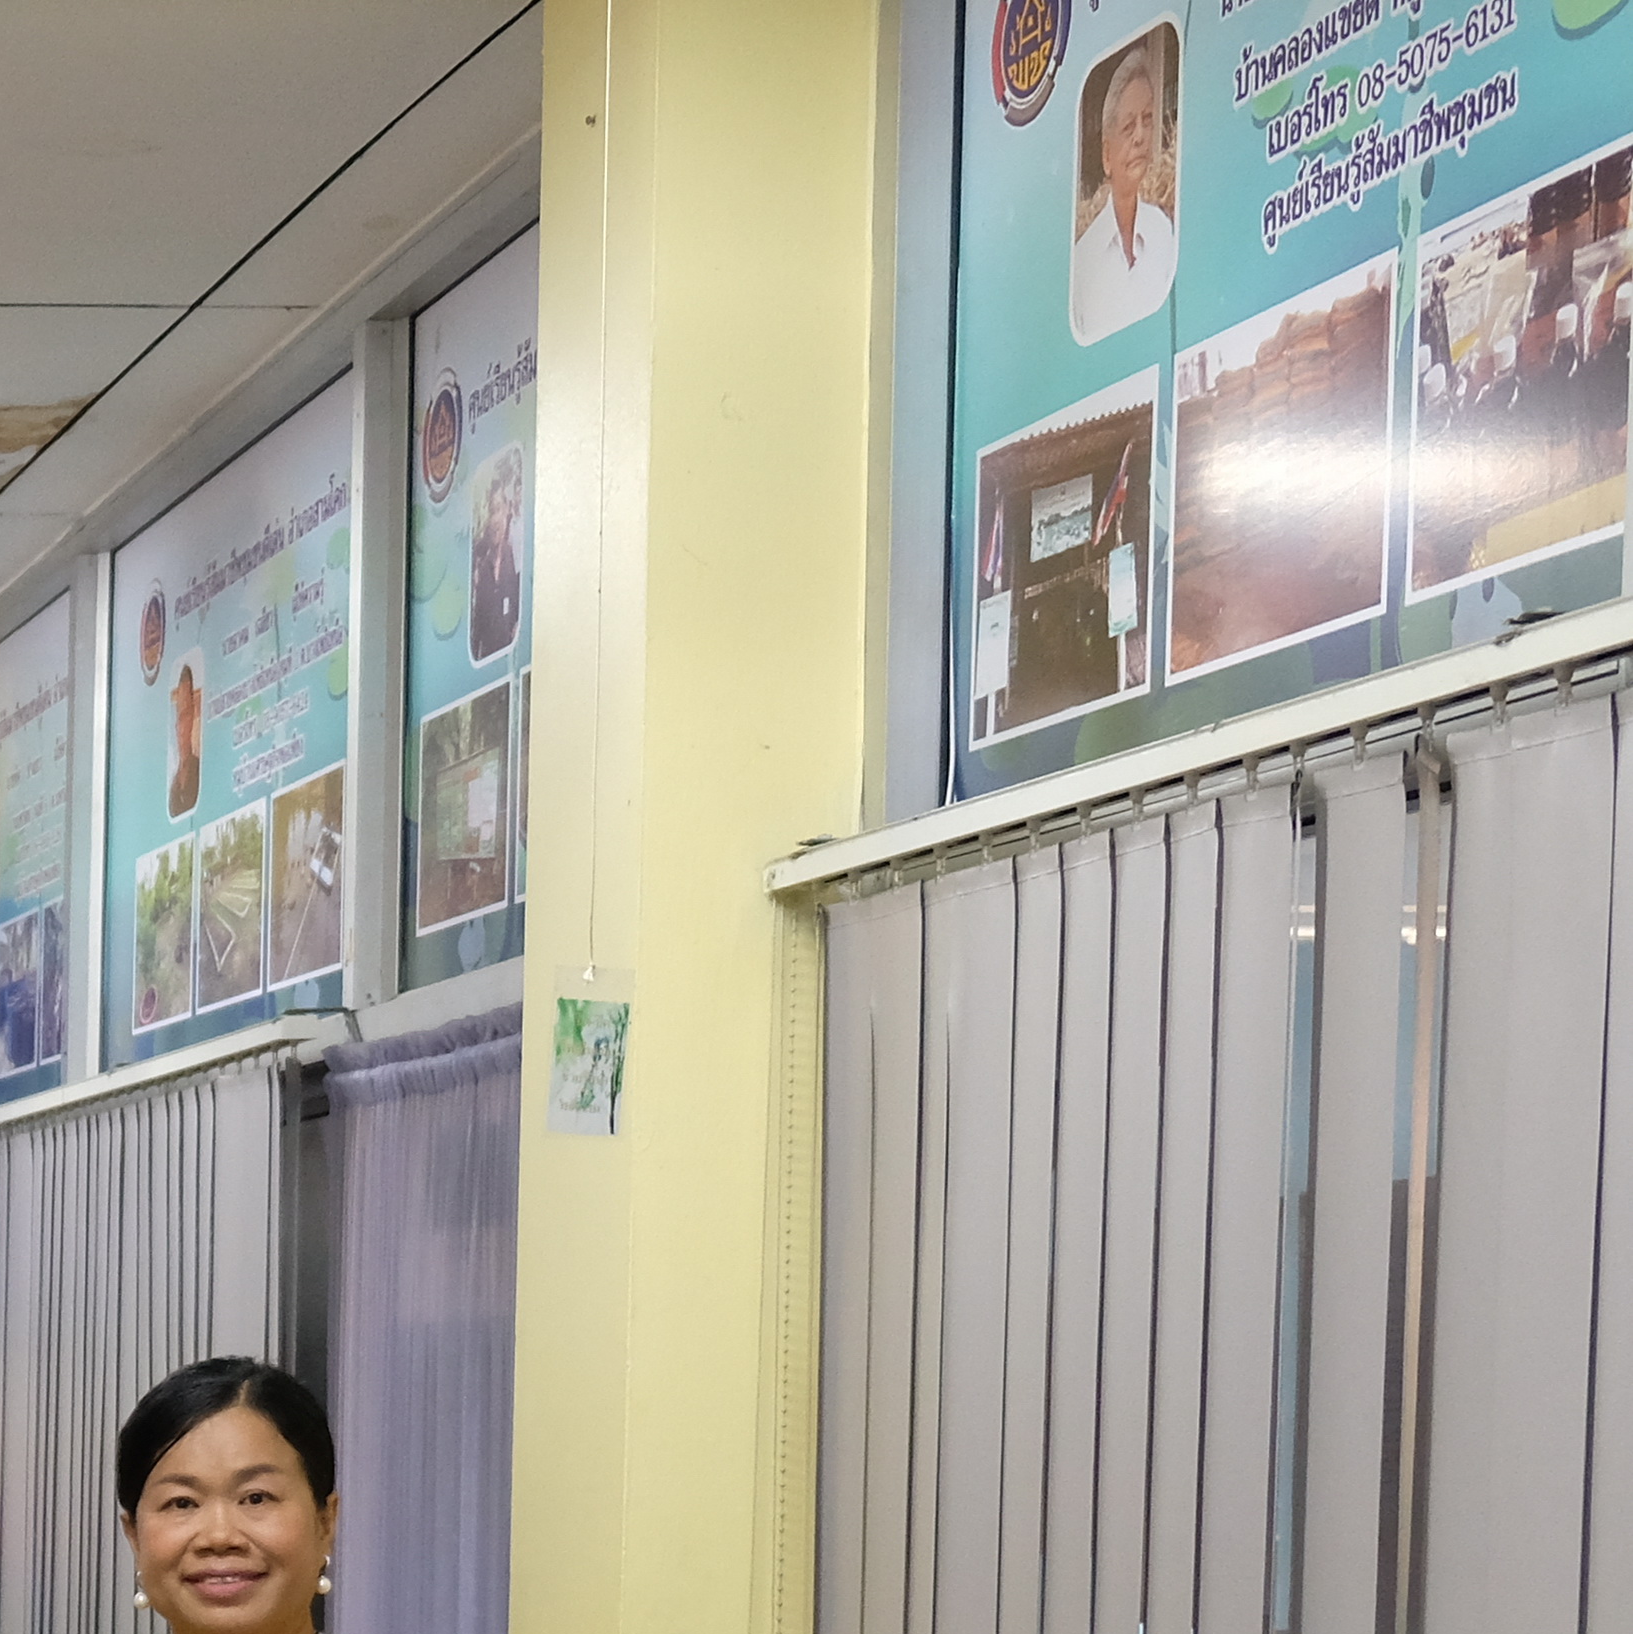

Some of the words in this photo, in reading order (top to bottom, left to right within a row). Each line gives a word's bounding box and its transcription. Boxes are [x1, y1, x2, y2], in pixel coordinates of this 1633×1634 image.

[1357, 0, 1515, 108] 08-5075-6131
[1263, 71, 1516, 248] ศูนย์เรียนรู้สัมมาชีพชุมชน
